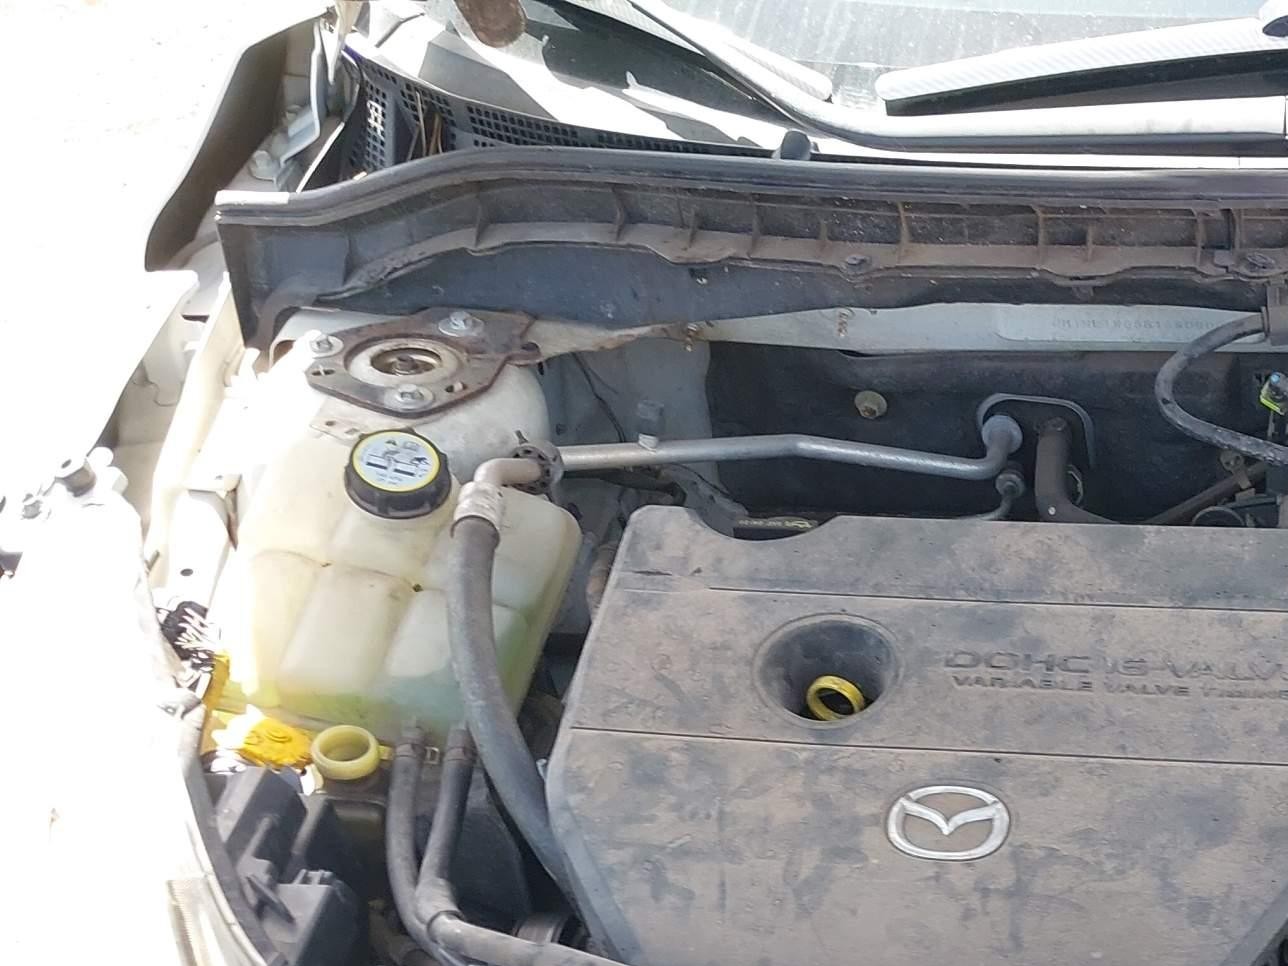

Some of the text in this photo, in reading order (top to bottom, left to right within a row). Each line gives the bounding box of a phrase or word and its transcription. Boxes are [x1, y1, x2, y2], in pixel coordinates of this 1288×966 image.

[944, 650, 1091, 674] DOHC
[952, 674, 1094, 692] VARIABLE
[1103, 680, 1190, 697] VALVE
